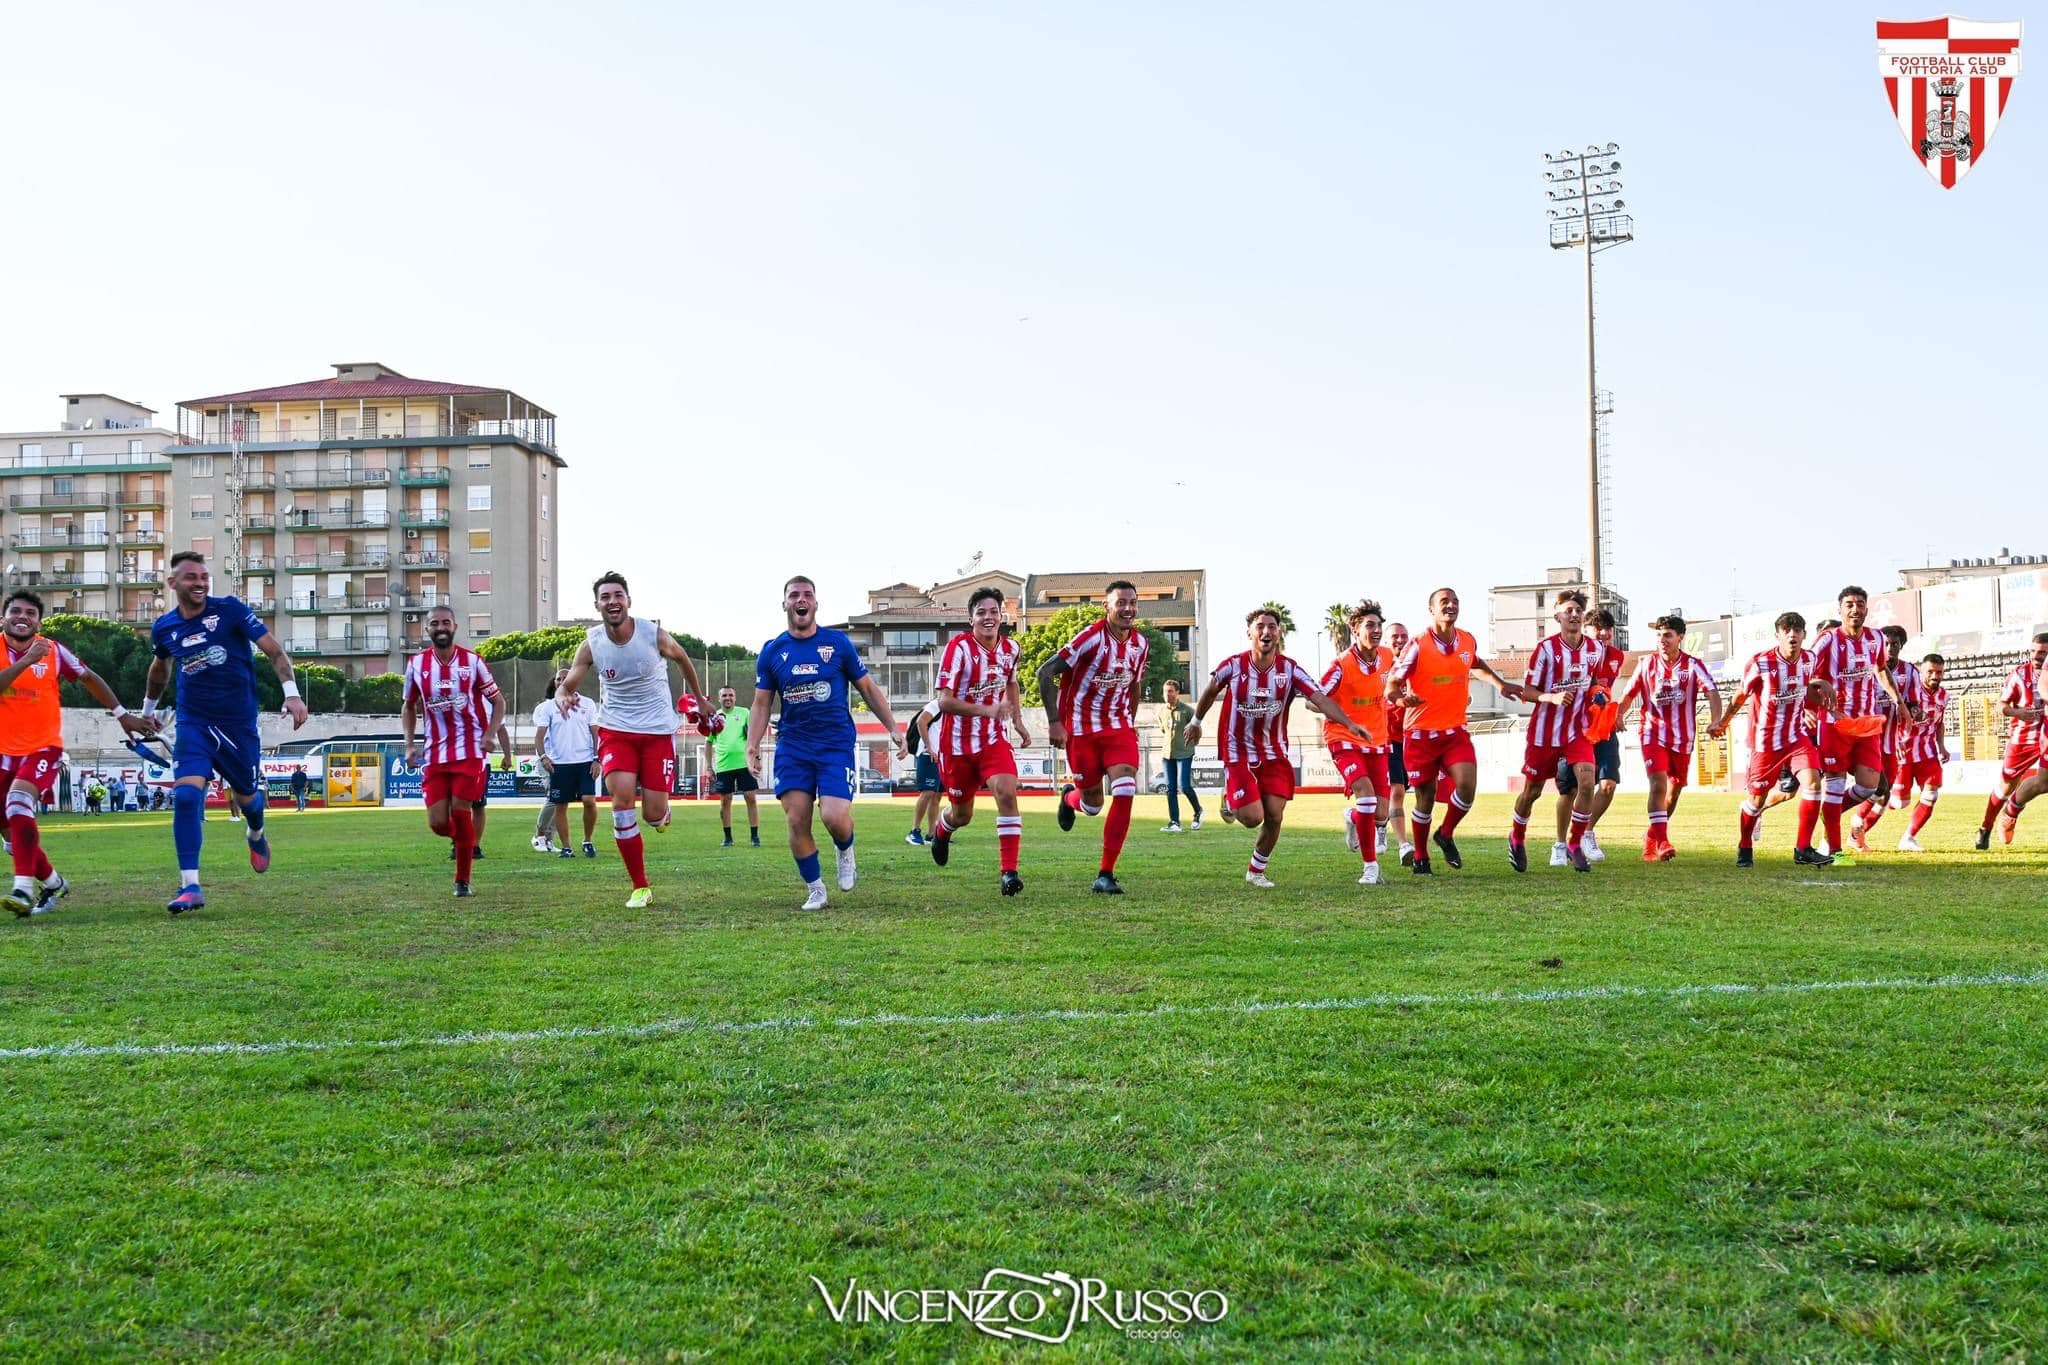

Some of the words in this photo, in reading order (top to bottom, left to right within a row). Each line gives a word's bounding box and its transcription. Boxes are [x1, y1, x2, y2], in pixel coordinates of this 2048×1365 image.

[605, 669, 616, 679] 19
[37, 759, 48, 772] 8
[663, 759, 674, 775] 15
